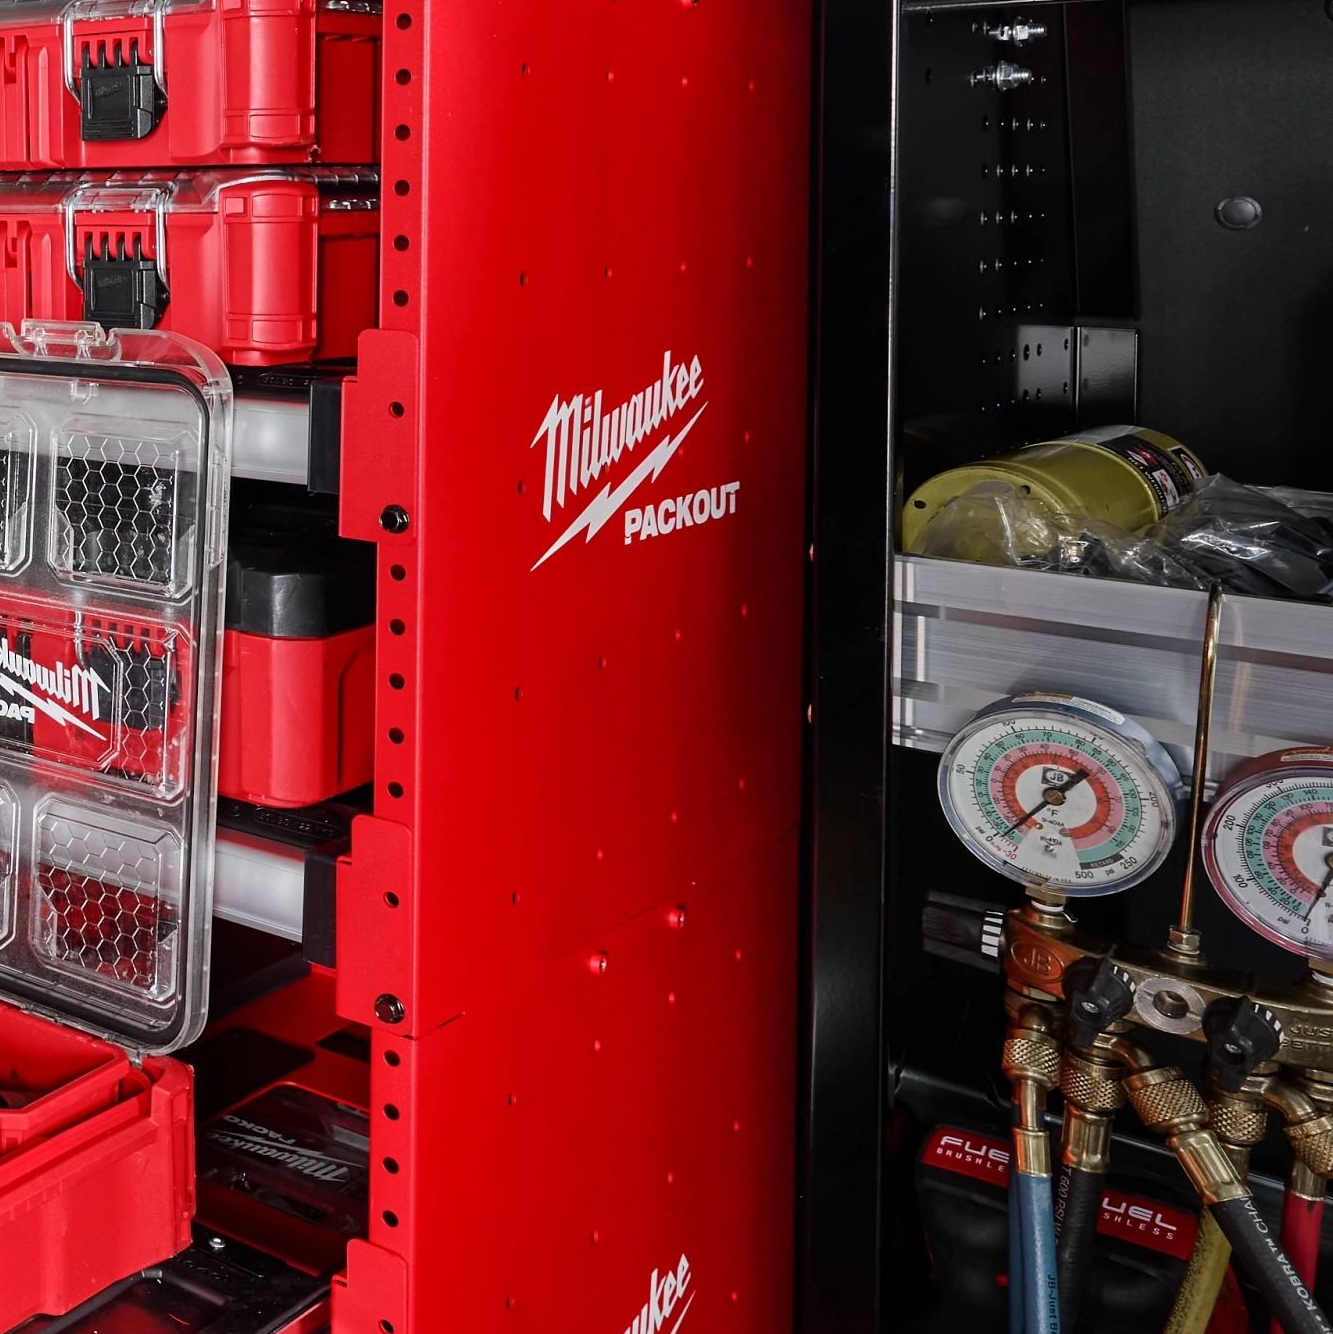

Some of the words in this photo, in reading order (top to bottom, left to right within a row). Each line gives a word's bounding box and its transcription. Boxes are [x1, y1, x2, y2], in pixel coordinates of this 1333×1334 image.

[530, 350, 704, 522] Milwaukee
[625, 481, 740, 545] PACKOUT
[1148, 791, 1159, 808] 200
[1223, 814, 1236, 831] 200
[1075, 870, 1094, 880] 500
[1120, 856, 1138, 870] 250
[1233, 874, 1248, 889] 100
[1024, 945, 1053, 976] JB
[1290, 1025, 1333, 1038] JUS
[223, 1114, 296, 1144] PACKO
[936, 1147, 1005, 1173] BRUSHLE
[940, 1136, 1010, 1164] FUE
[1058, 1176, 1068, 1198] 600
[1102, 1197, 1177, 1231] UEL
[1103, 1212, 1174, 1241] SHLESS
[1047, 1274, 1058, 1317] JB-Just
